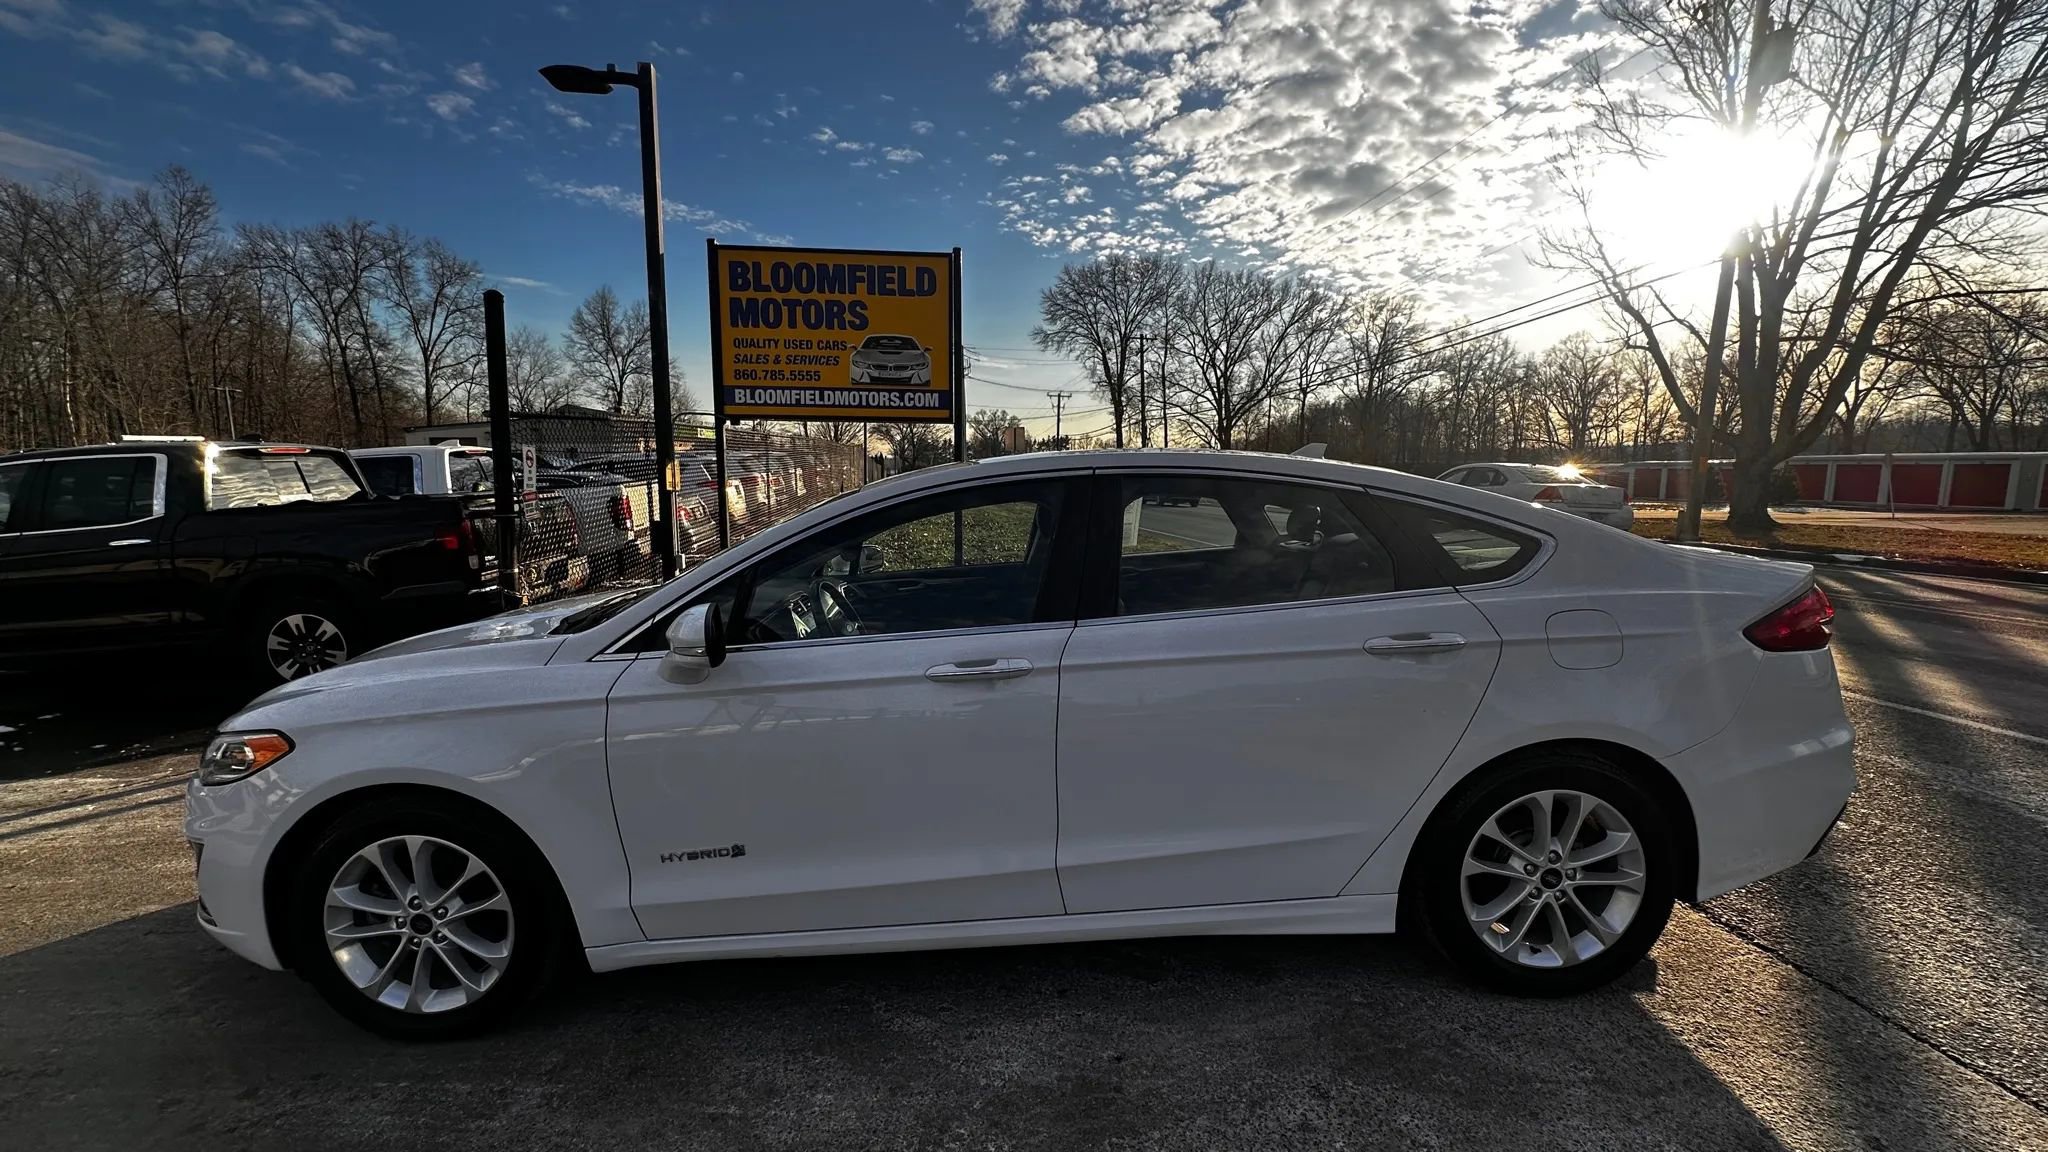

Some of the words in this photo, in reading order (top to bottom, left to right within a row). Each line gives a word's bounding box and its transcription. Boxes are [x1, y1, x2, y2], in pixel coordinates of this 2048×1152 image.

[728, 260, 937, 297] BLOOMFIELD
[729, 297, 869, 331] MOTORS
[733, 337, 780, 350] QUALITY
[783, 339, 813, 350] USED
[817, 340, 848, 351] CARS
[733, 353, 770, 365] SALES
[773, 354, 782, 365] &
[785, 355, 840, 366] SERVICES
[733, 368, 821, 382] 860.785.5555
[734, 388, 939, 407] BLOOMFIELDMOTORS.COM
[660, 848, 731, 864] HYBRID
